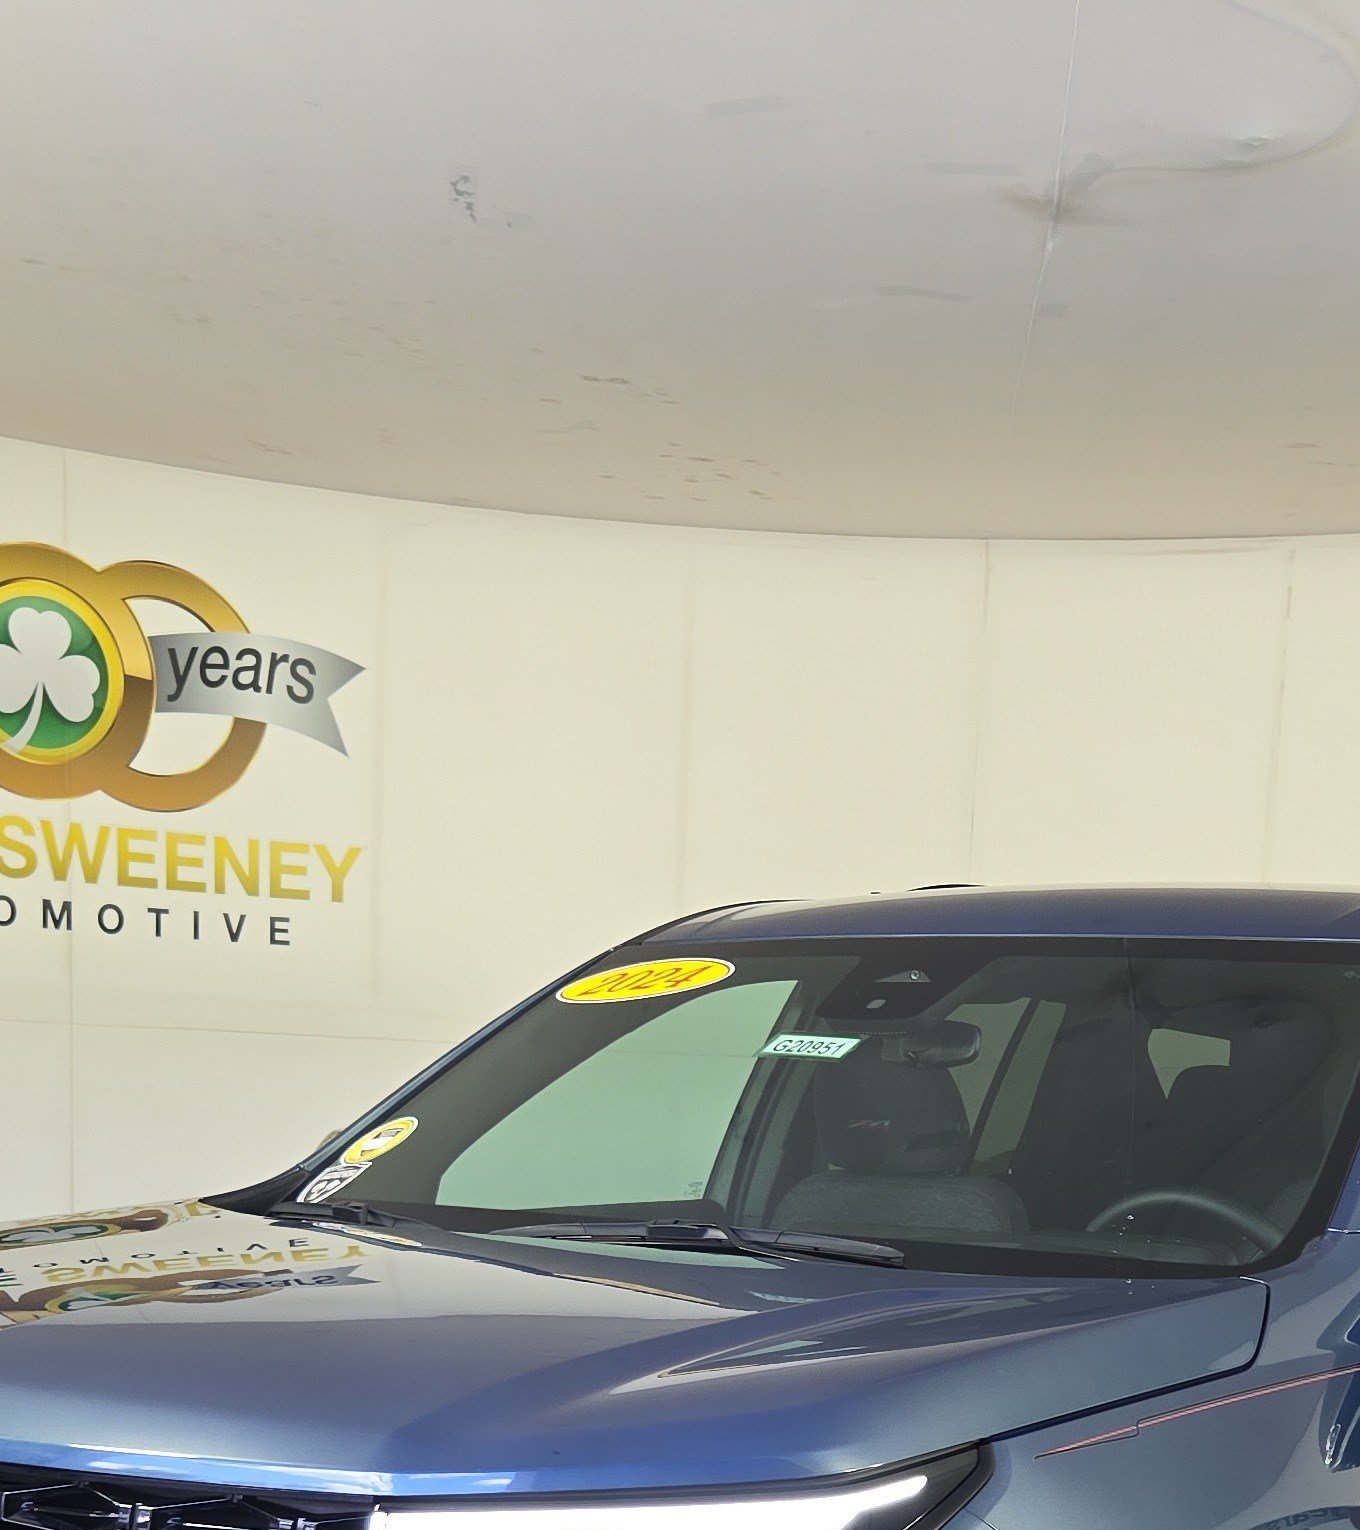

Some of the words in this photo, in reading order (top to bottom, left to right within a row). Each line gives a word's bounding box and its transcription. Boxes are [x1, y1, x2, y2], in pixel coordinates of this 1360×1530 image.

[166, 645, 316, 705] years
[576, 965, 713, 997] 2024
[773, 1038, 848, 1056] G20951
